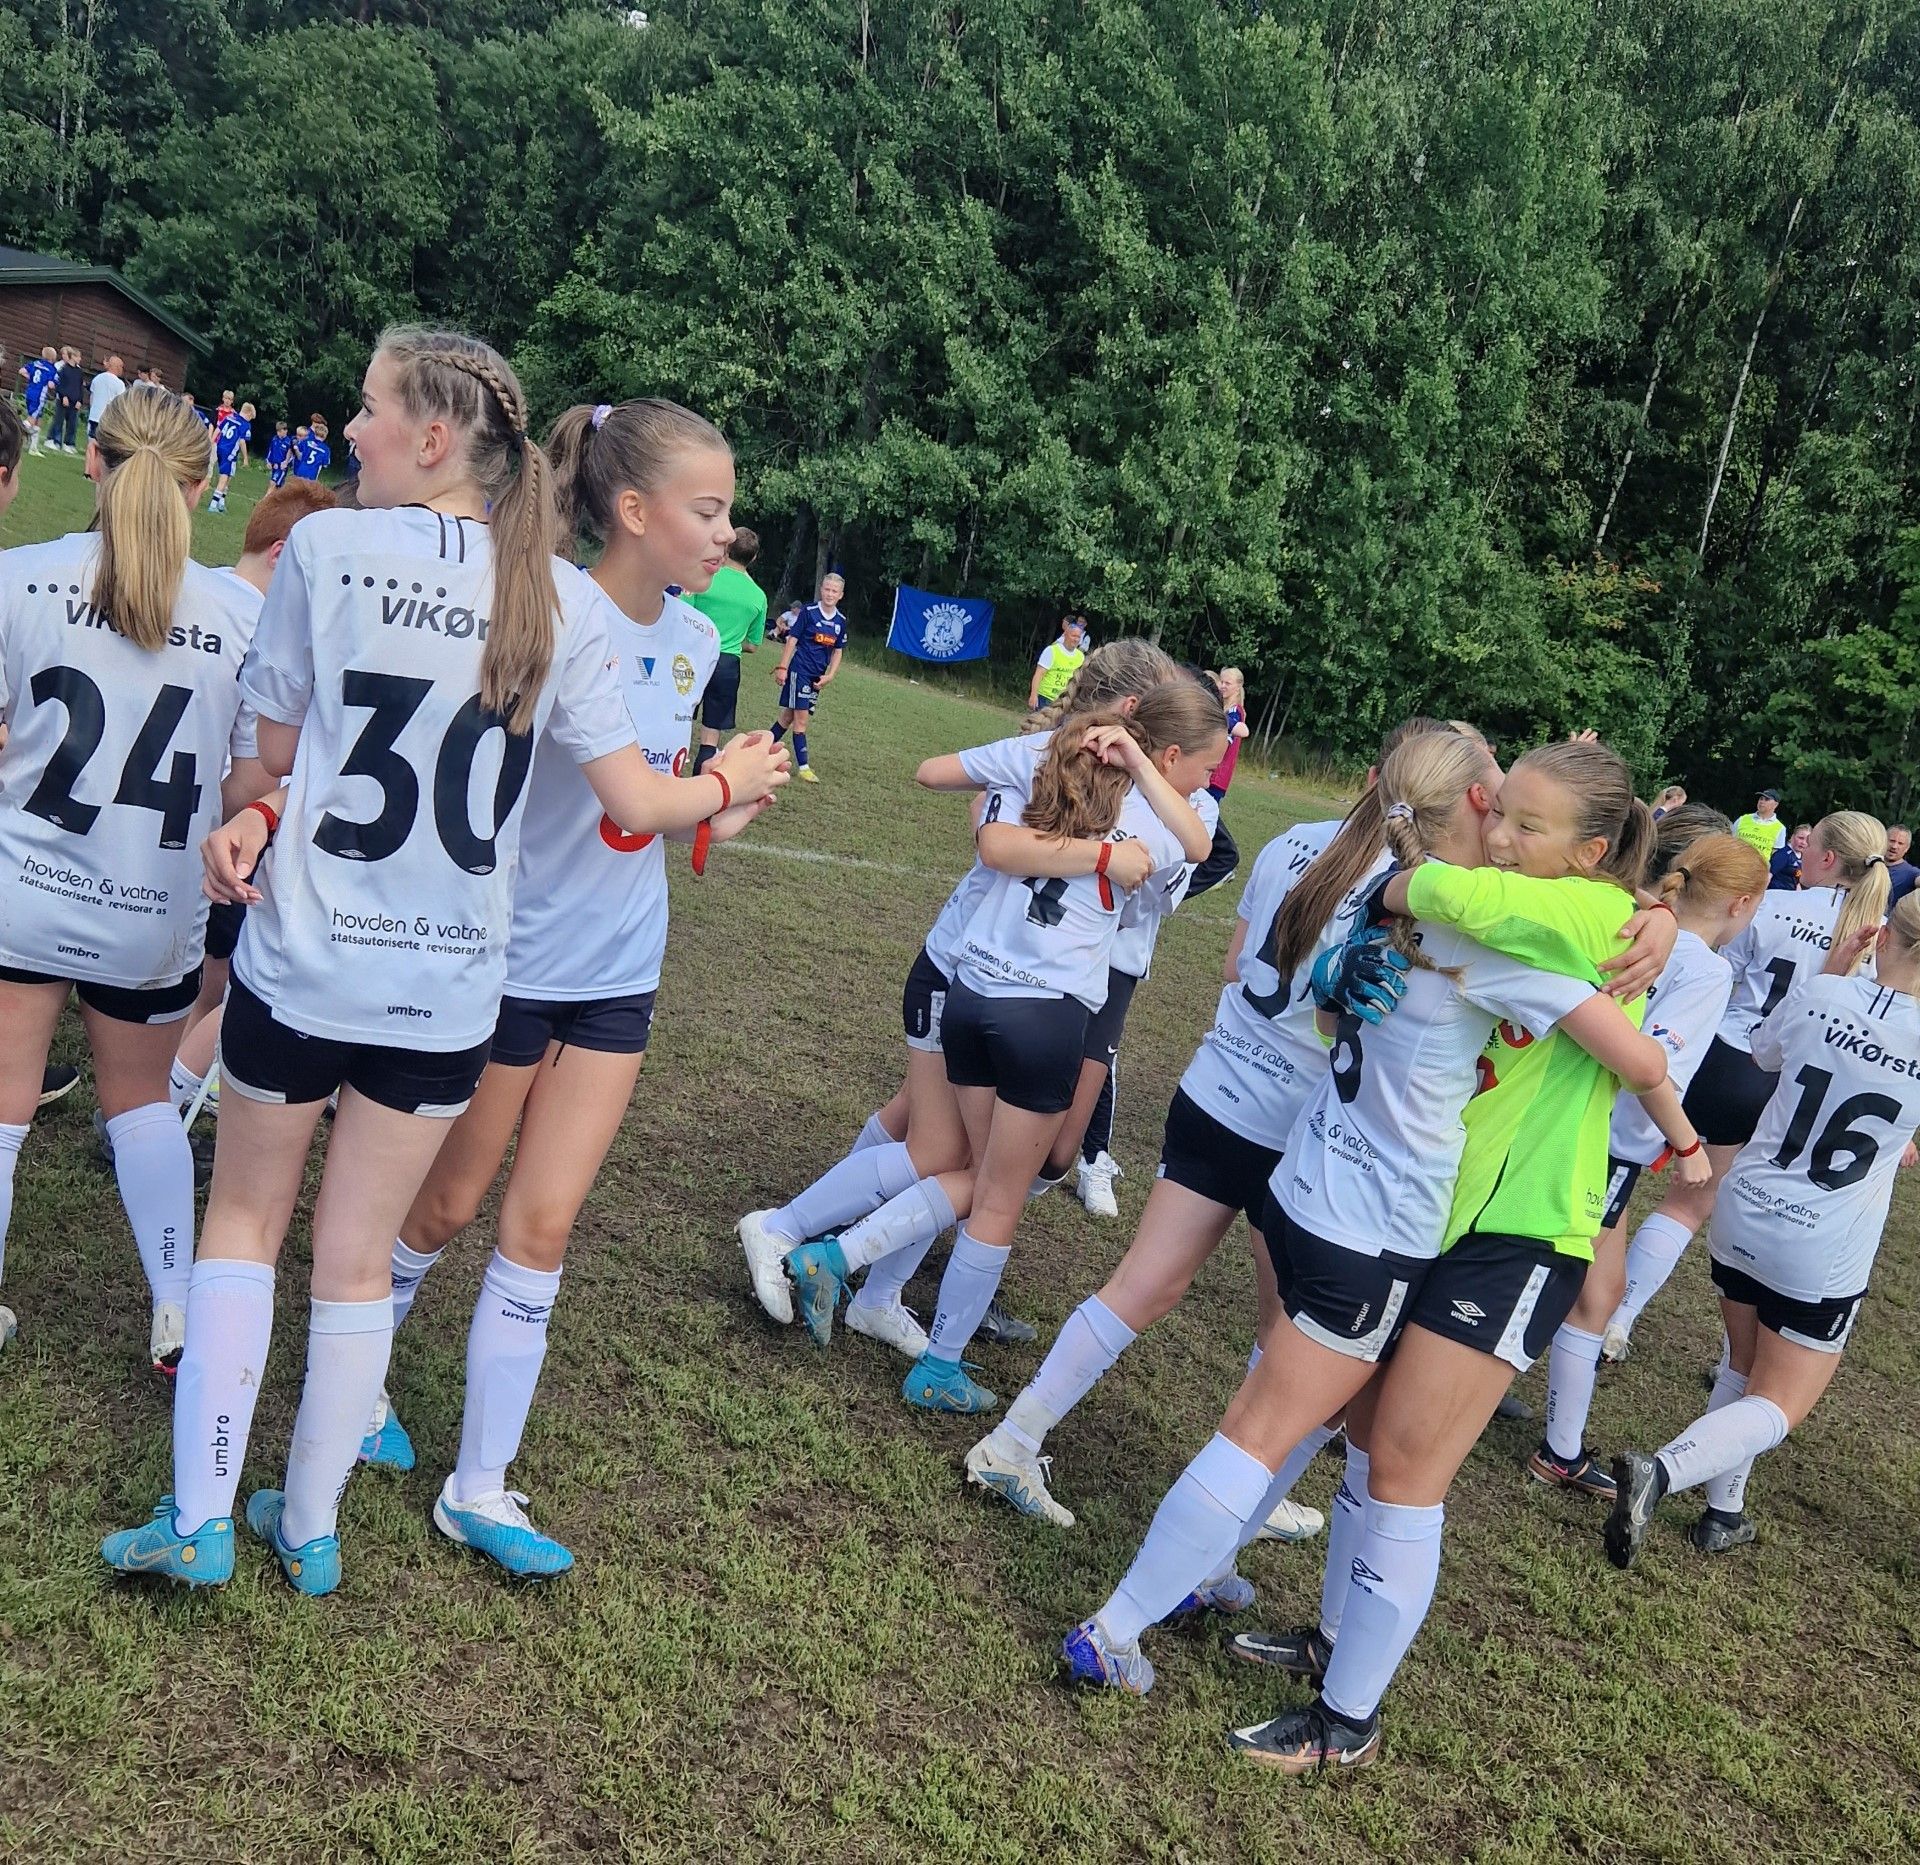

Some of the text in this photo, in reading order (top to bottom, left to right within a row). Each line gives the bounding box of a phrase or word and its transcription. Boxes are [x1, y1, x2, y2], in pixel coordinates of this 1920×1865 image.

[307, 450, 317, 464] 5
[22, 665, 202, 850] 24
[312, 669, 534, 876] 30
[24, 855, 169, 903] hovden & vatne
[19, 874, 103, 906] statsautoriserte
[155, 906, 168, 916] as
[333, 908, 488, 941] hovden & vatne
[57, 944, 100, 960] umbro
[330, 932, 420, 951] statsautoriserte
[426, 943, 476, 956] revisorar
[1001, 960, 1013, 974] &
[1013, 968, 1048, 988] vatne
[387, 1004, 432, 1019] umbro
[1215, 1022, 1295, 1074] hovden & vatne
[1217, 1083, 1240, 1104] umbro
[1328, 1123, 1342, 1140] &
[1342, 1133, 1378, 1159] vatne
[1767, 1063, 1903, 1192] 16
[1785, 1203, 1821, 1221] vatne
[163, 1226, 176, 1271] umbro
[1732, 1244, 1757, 1261] umbro
[501, 1309, 548, 1324] umbro
[931, 1312, 948, 1345] umbro
[1350, 1302, 1371, 1332] umbro
[1450, 1310, 1479, 1326] umbro
[1549, 1389, 1558, 1423] umbro
[215, 1413, 231, 1477] umbro
[1727, 1474, 1743, 1499] umbro
